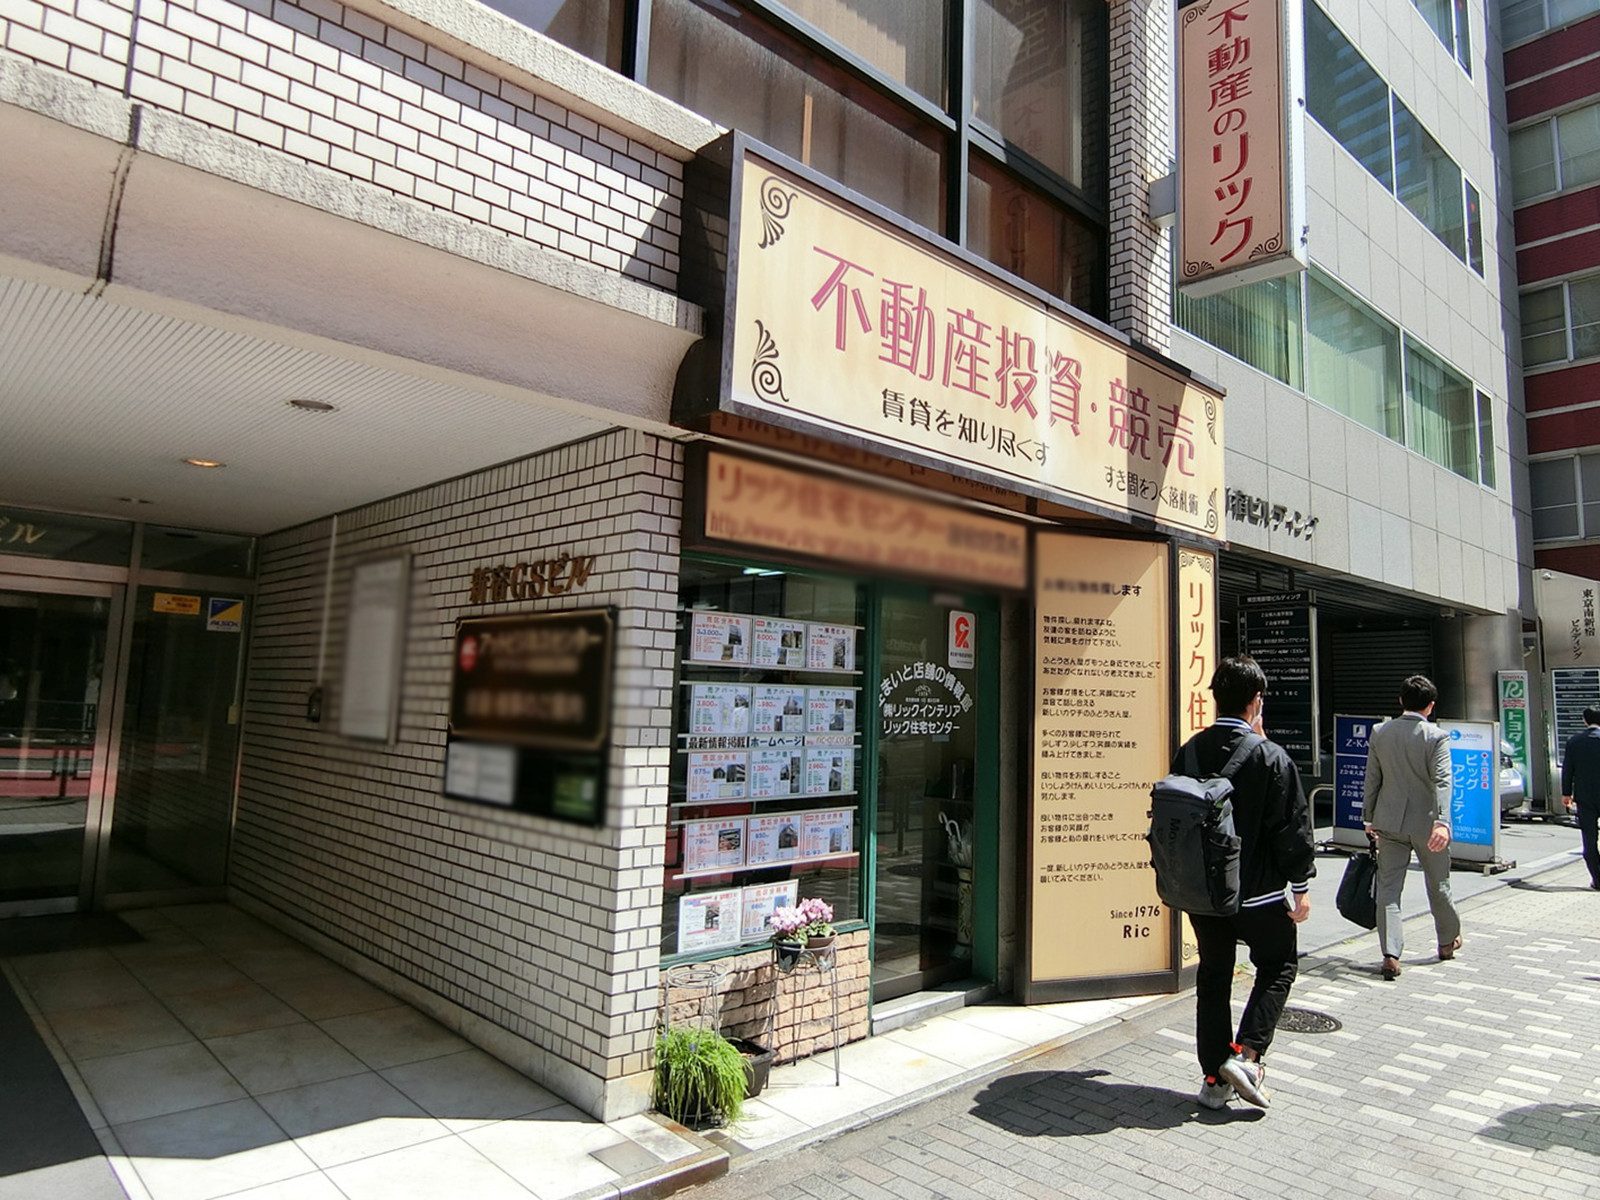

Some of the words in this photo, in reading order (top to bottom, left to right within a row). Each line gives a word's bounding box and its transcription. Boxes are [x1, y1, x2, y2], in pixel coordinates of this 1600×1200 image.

[1207, 0, 1254, 264] 不動産のリック
[811, 246, 1195, 477] 不動産投資・競売
[881, 387, 1050, 467] 賃貸を知り尽くす
[1104, 465, 1199, 517] すき間をつく落札術
[688, 736, 747, 749] 最新情報掲載
[750, 736, 801, 747] ホームページ
[883, 720, 960, 734] リック住宅センター
[1465, 753, 1479, 790] ビッグ
[1110, 909, 1134, 919] Since
[1135, 905, 1160, 918] 1976
[1123, 924, 1150, 939] Ric
